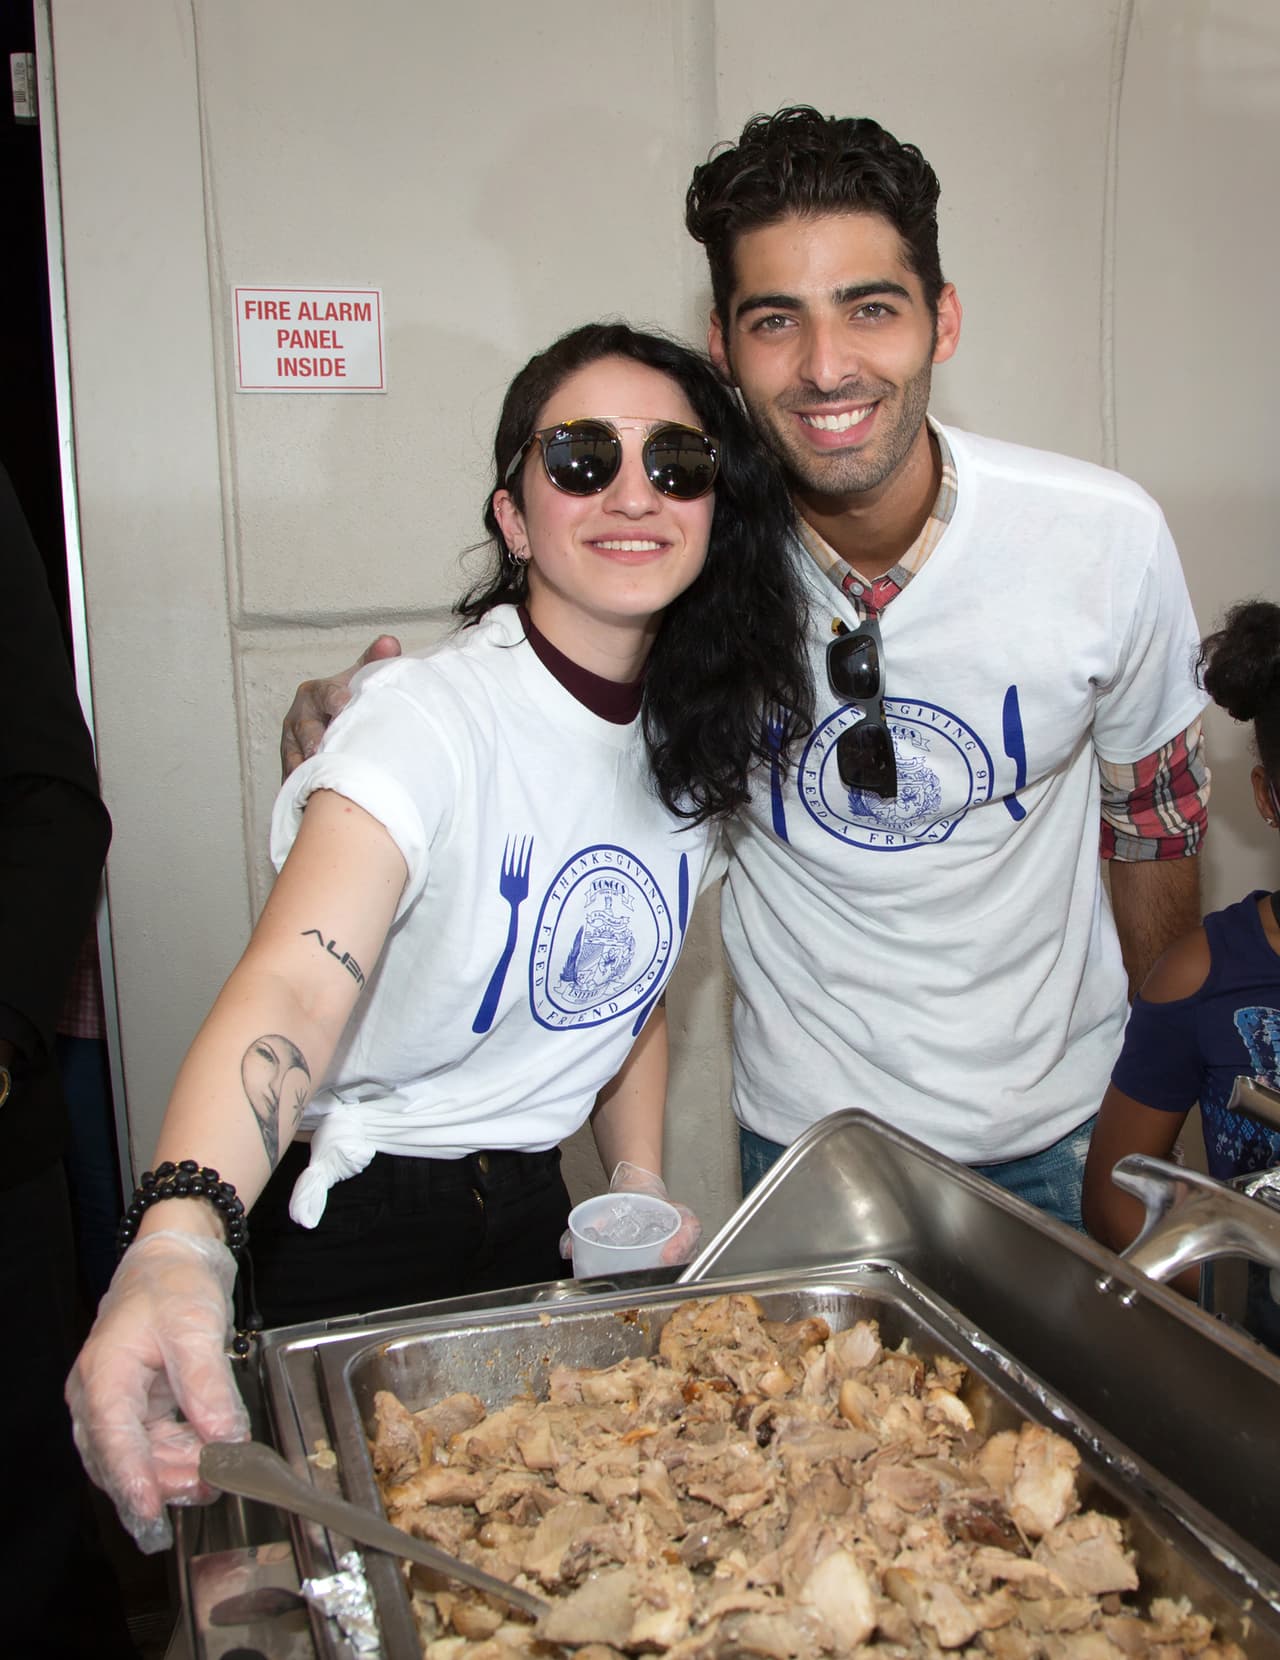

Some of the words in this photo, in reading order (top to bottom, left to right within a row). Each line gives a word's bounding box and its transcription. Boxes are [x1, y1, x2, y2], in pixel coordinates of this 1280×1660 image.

[244, 300, 291, 320] FIRE
[297, 301, 372, 322] ALARM
[277, 329, 344, 349] PANEL
[277, 357, 346, 377] INSIDE
[813, 702, 977, 751] THANSGIVING
[805, 770, 828, 819] FEED
[838, 825, 848, 835] A
[551, 851, 665, 915] THANKSGIVING
[535, 925, 552, 987] FEED
[546, 1002, 618, 1025] FRIEND
